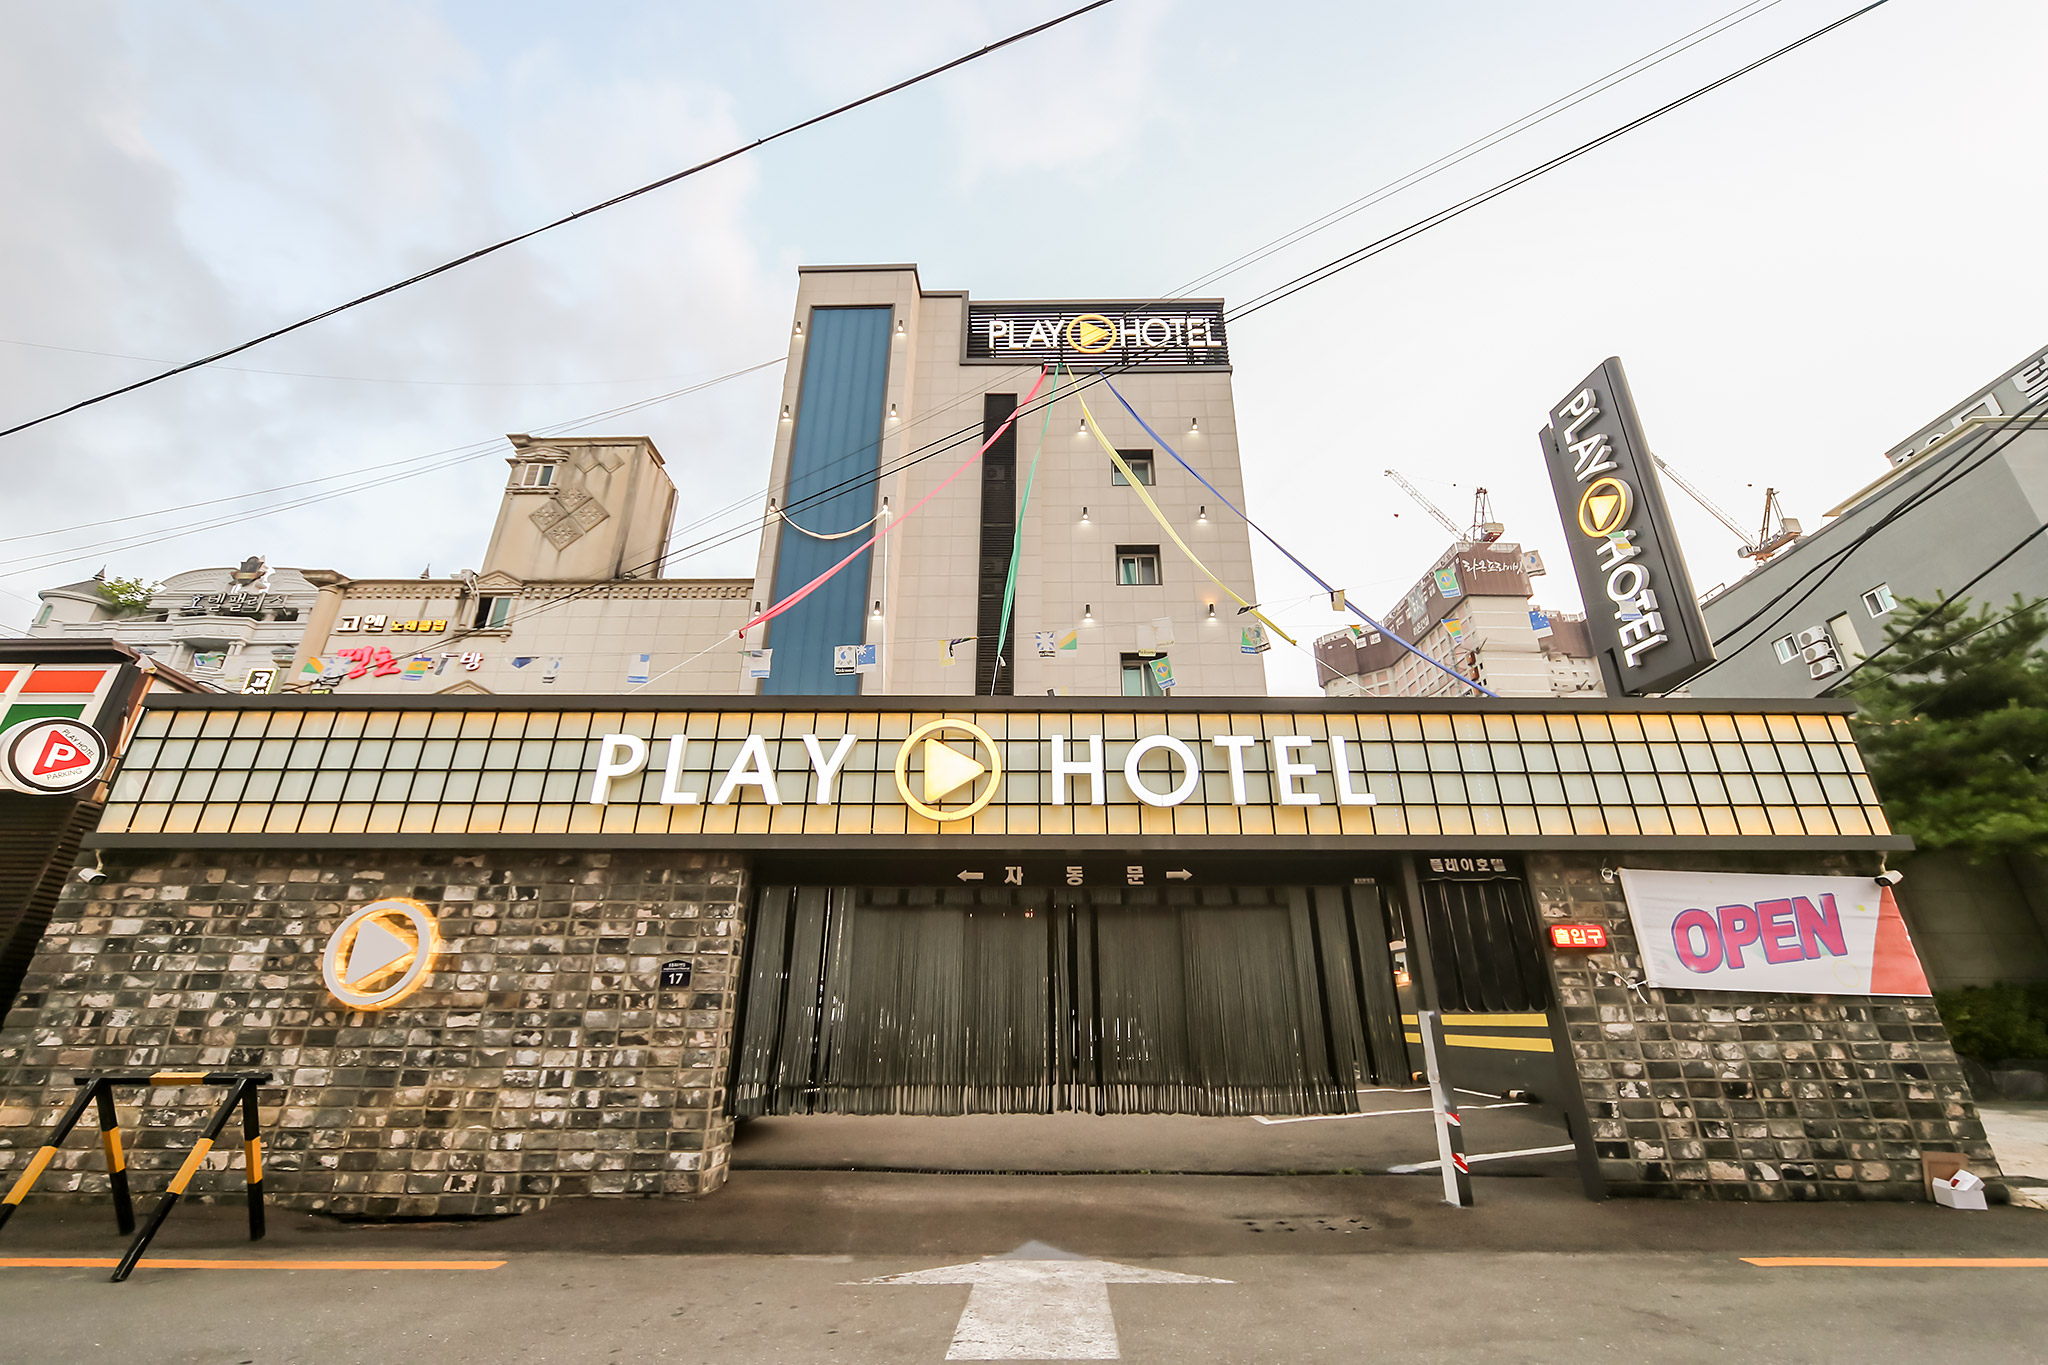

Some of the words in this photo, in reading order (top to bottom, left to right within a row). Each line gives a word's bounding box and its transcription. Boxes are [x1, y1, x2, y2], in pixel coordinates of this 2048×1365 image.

[988, 319, 1065, 349] PLAY
[1119, 317, 1223, 349] HOTEL
[1558, 387, 1618, 483] PLAY
[1596, 529, 1668, 668] HOTEL
[336, 614, 387, 632] 고엔
[43, 742, 77, 769] P
[61, 728, 78, 743] PLAY
[77, 740, 95, 759] HOTEL
[46, 767, 83, 780] PARKING
[589, 733, 859, 807] PLAY
[1050, 733, 1379, 808] HOTEL
[1429, 857, 1508, 873] 플레이호텔
[1554, 928, 1603, 946] 출입구
[1671, 892, 1849, 974] OPEN
[668, 972, 684, 986] 17
